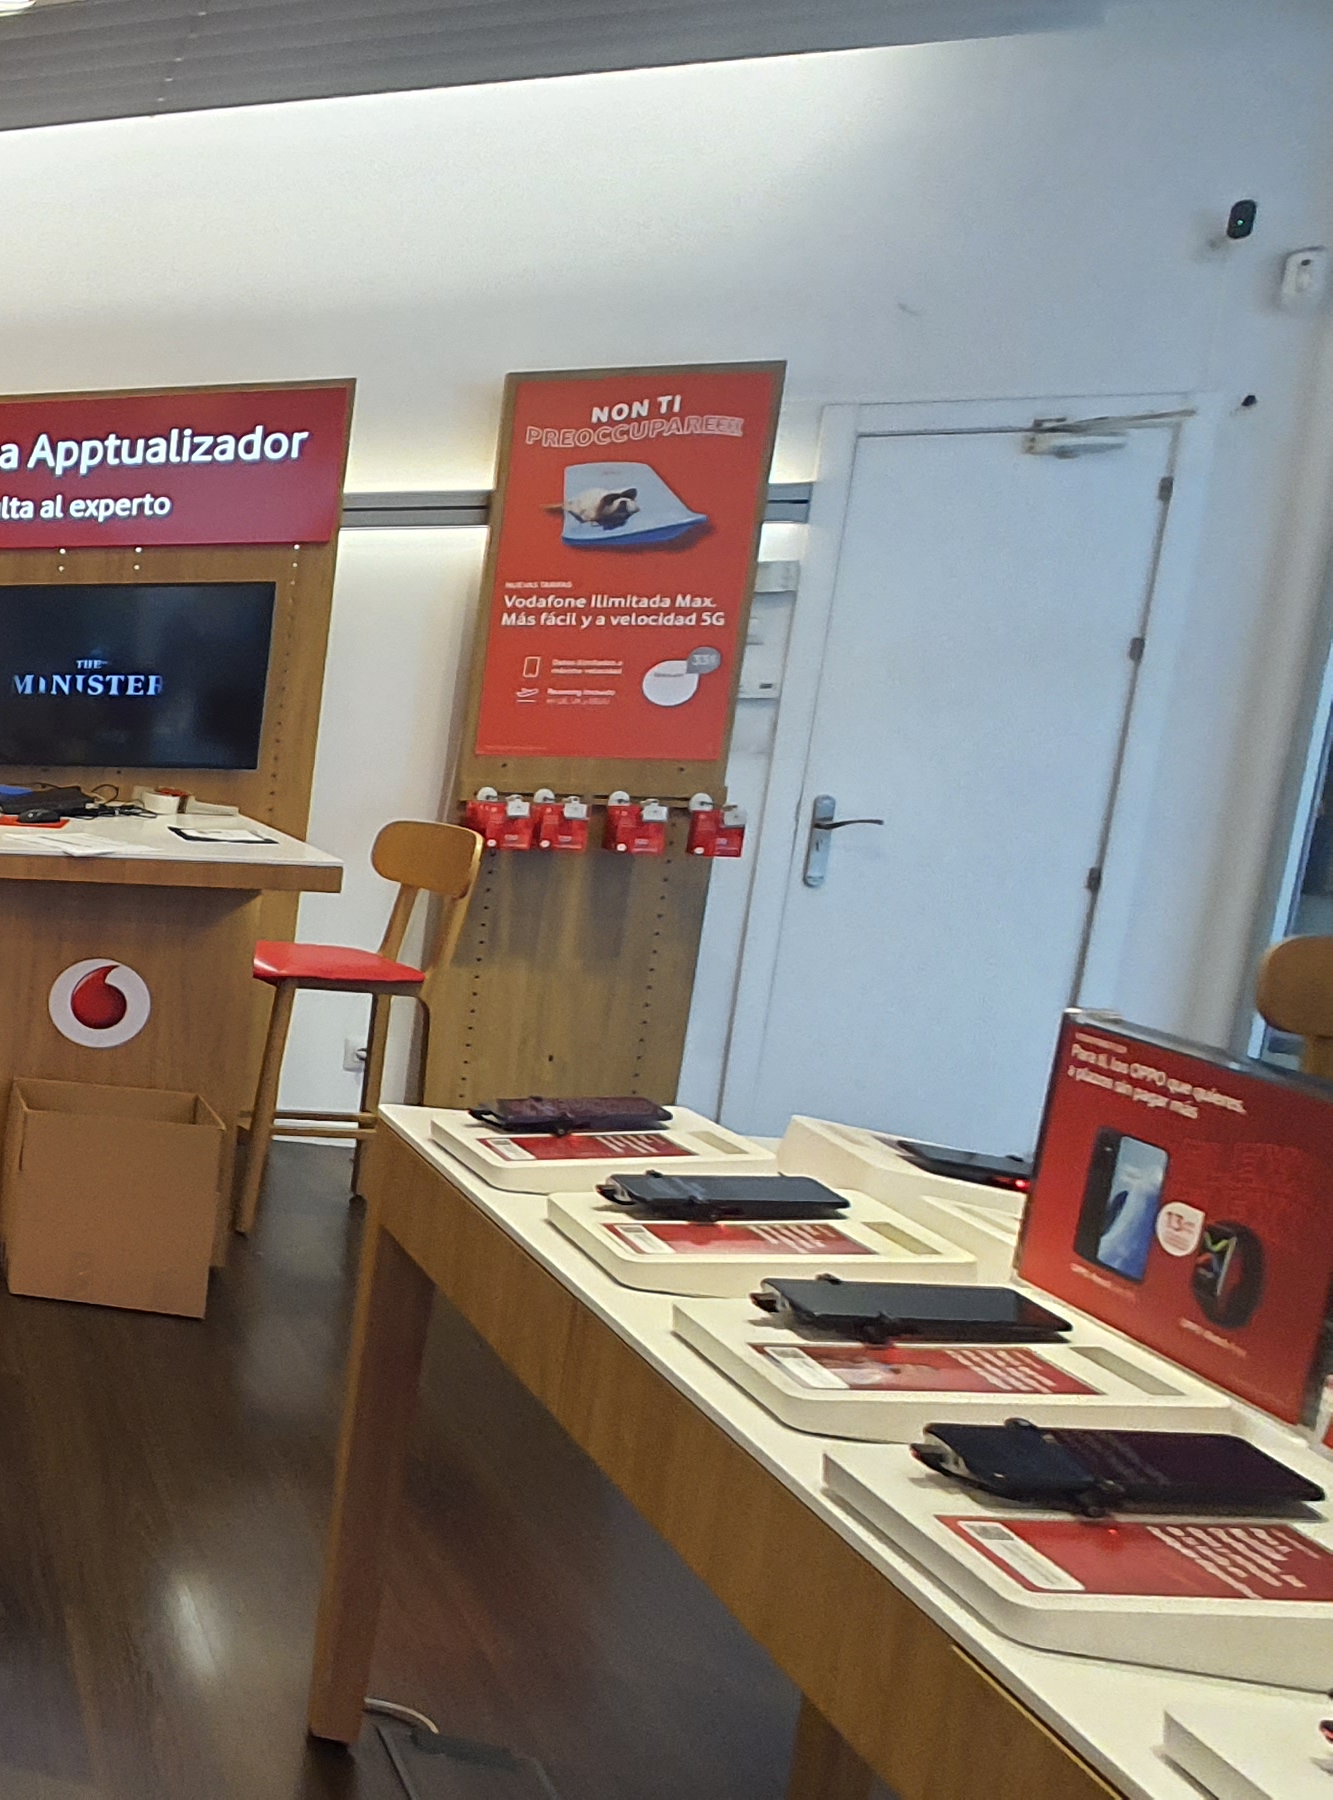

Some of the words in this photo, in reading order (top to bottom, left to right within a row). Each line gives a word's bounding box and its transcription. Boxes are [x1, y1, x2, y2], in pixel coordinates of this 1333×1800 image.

[590, 398, 650, 424] NON
[656, 394, 682, 416] TI
[26, 424, 310, 476] Apptualizador
[39, 493, 64, 519] al
[68, 493, 172, 523] experto
[503, 594, 587, 609] Vodafone
[590, 593, 671, 609] Ilimitada
[674, 593, 717, 609] Max.
[501, 611, 537, 627] Más
[539, 612, 577, 627] fácil
[579, 615, 593, 630] y
[595, 615, 607, 627] a
[609, 611, 697, 627] velocidad
[699, 611, 726, 627] 5G
